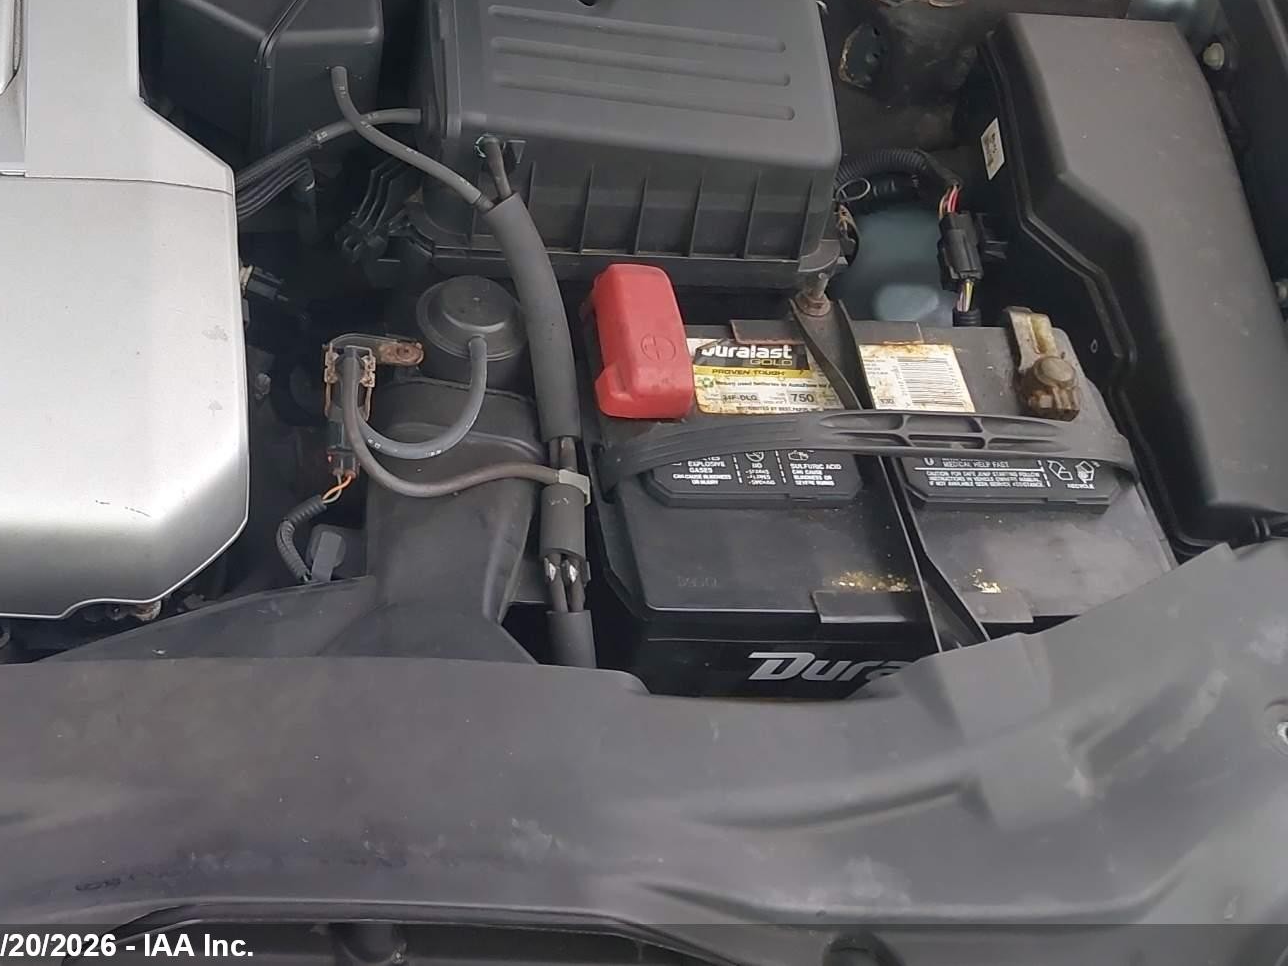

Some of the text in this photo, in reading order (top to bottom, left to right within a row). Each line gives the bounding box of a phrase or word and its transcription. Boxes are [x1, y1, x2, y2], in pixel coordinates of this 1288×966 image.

[712, 368, 751, 376] PROVEN
[790, 393, 815, 402] 750
[943, 460, 972, 468] MEDICAL
[973, 460, 992, 468] HELP
